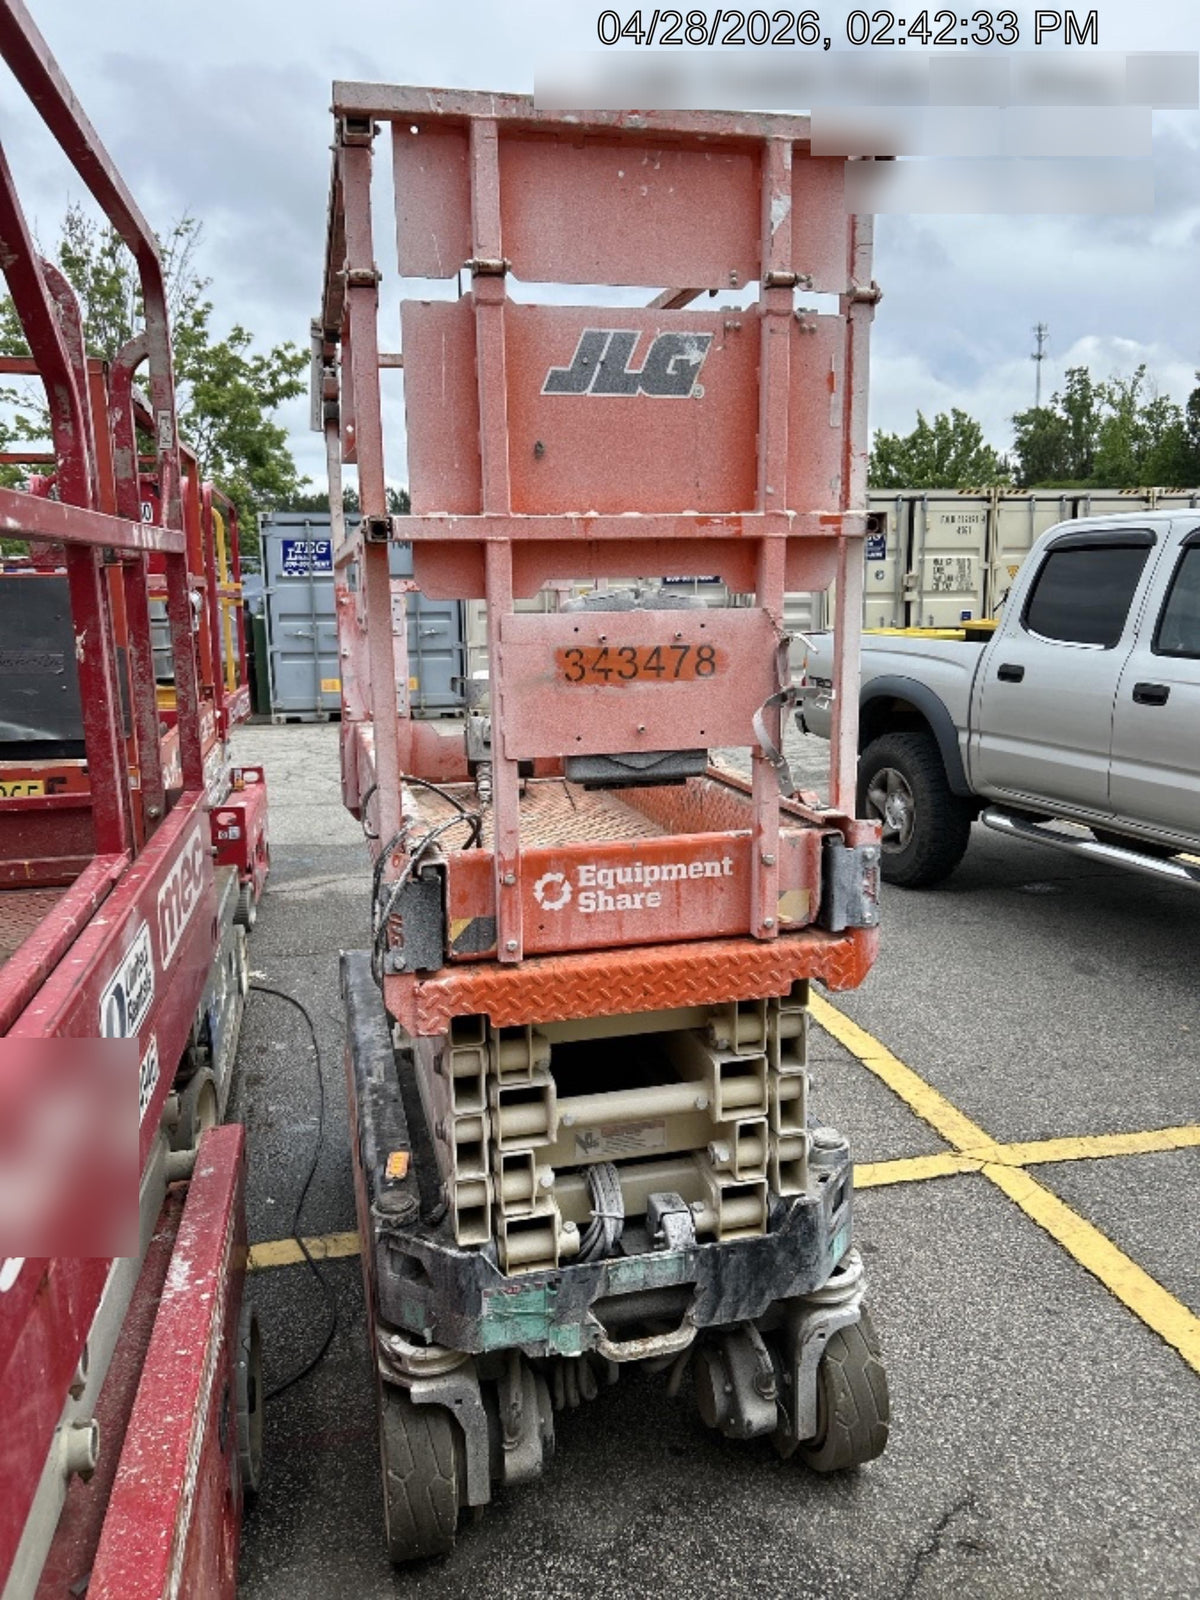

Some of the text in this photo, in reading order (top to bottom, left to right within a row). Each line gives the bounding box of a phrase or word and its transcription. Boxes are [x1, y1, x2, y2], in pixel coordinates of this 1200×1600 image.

[540, 328, 714, 398] JLG
[294, 541, 329, 554] TEG
[564, 644, 716, 683] 343478
[577, 856, 733, 889] Equipment
[578, 891, 662, 913] Share
